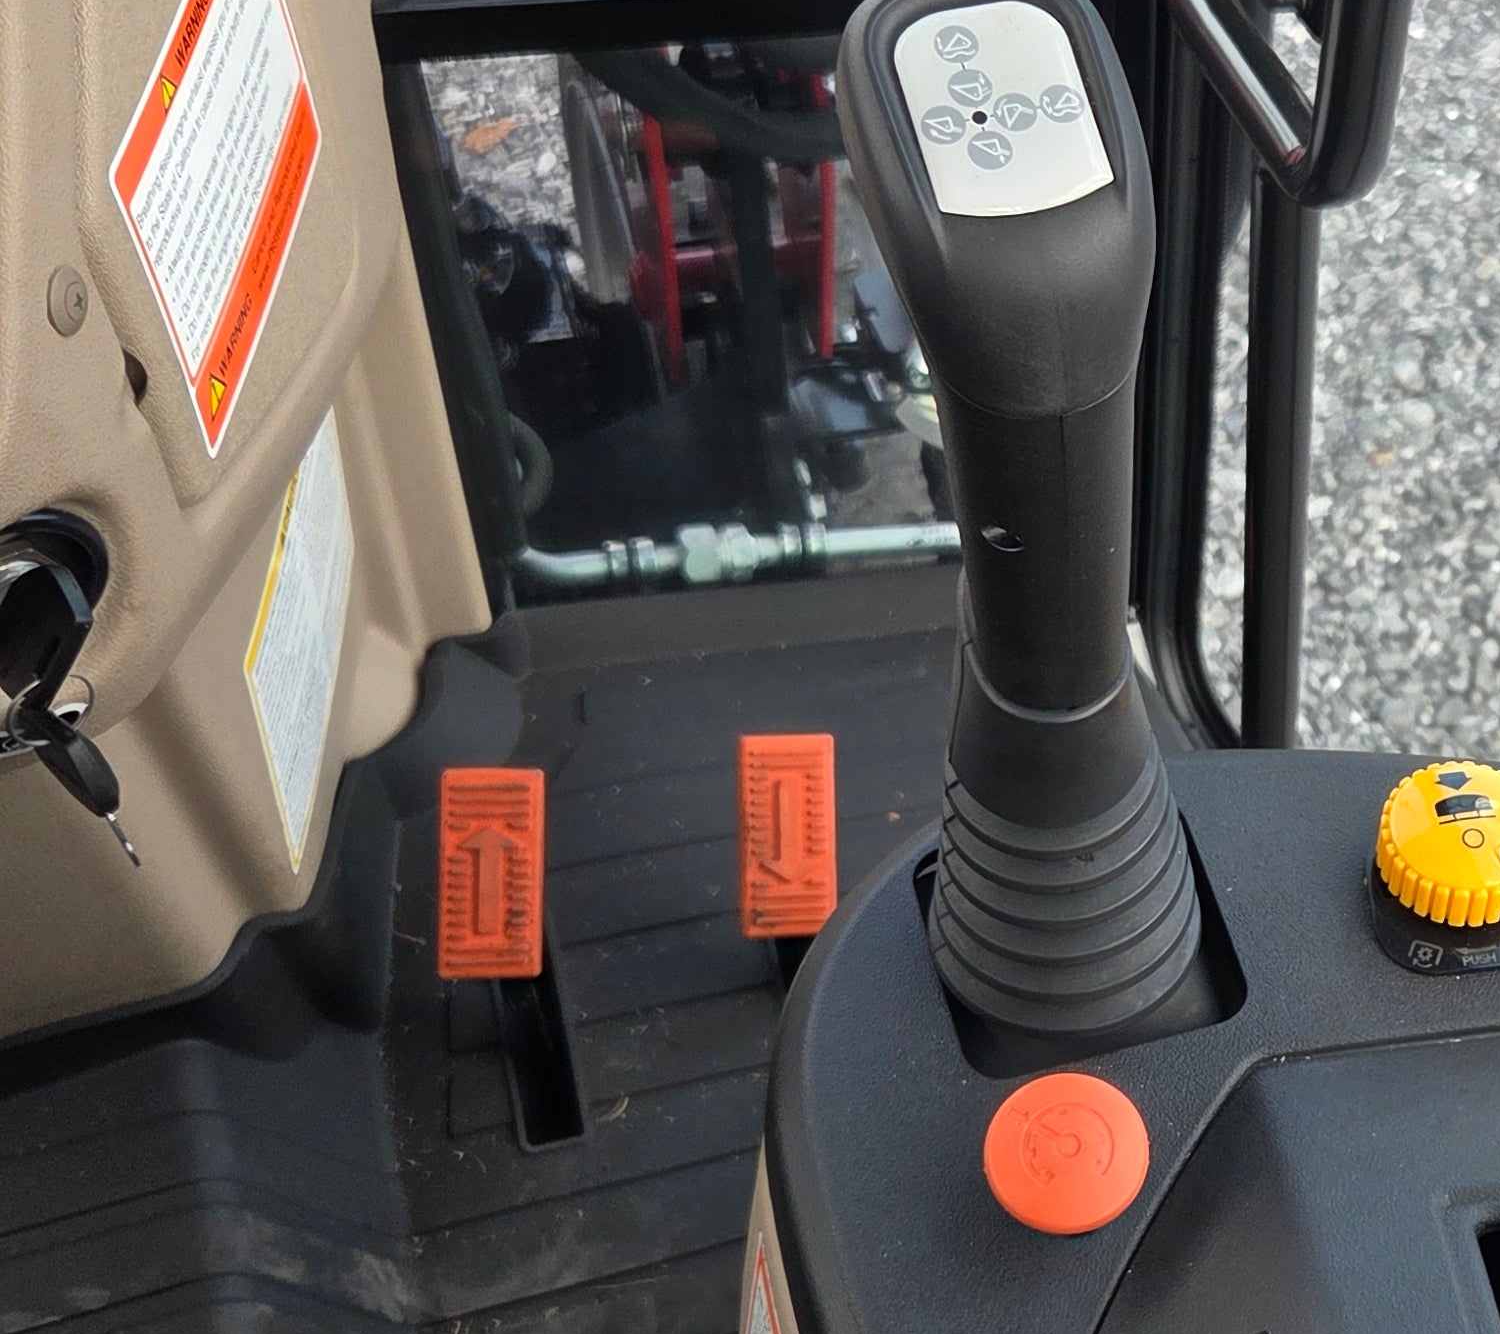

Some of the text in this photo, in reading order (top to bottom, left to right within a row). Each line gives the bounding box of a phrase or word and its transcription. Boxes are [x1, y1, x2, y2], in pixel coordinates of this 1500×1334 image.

[135, 171, 162, 233] Breathing
[150, 215, 160, 240] the
[157, 183, 173, 220] State
[174, 124, 197, 179] California
[153, 201, 182, 270] reproductive
[167, 234, 186, 281] Always
[181, 295, 190, 319] Do
[188, 276, 198, 302] not
[210, 254, 234, 314] information
[187, 314, 197, 338] Do
[195, 297, 205, 322] not
[218, 292, 252, 378] WARNING
[1462, 952, 1497, 966] PUSH
